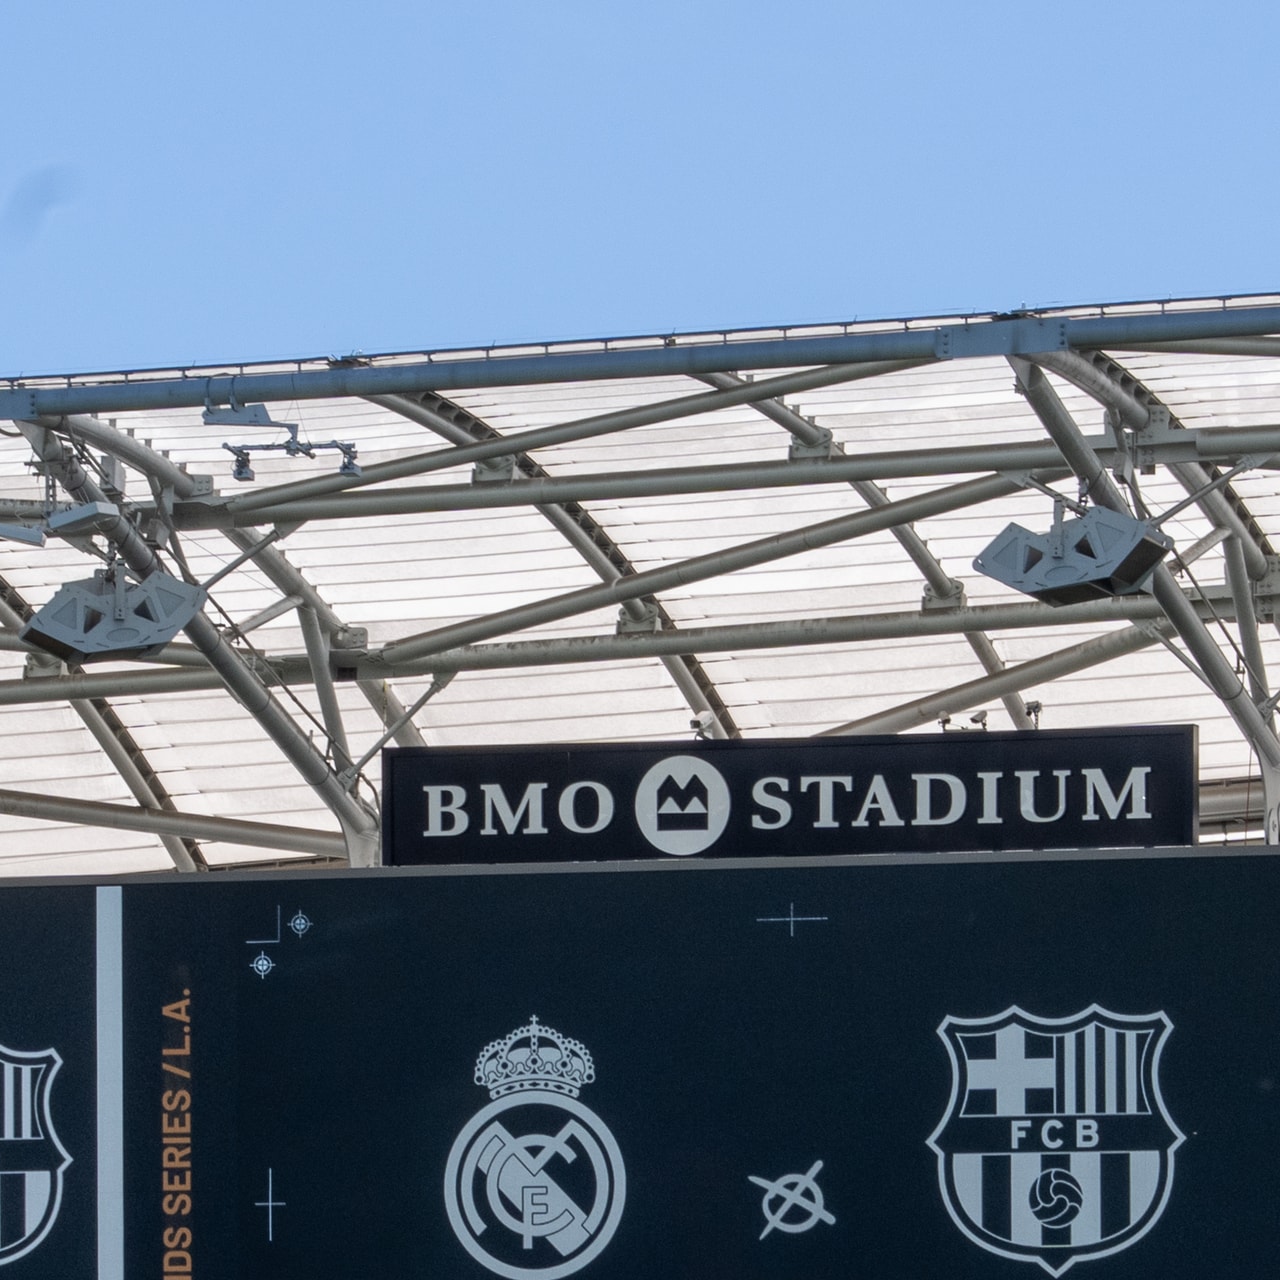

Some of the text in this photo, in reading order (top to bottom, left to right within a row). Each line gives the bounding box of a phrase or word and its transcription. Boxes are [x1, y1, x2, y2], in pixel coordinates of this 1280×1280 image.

[423, 767, 1152, 836] BMO STADIUM
[162, 1089, 191, 1215] SERIES
[1011, 1119, 1099, 1149] FCB
